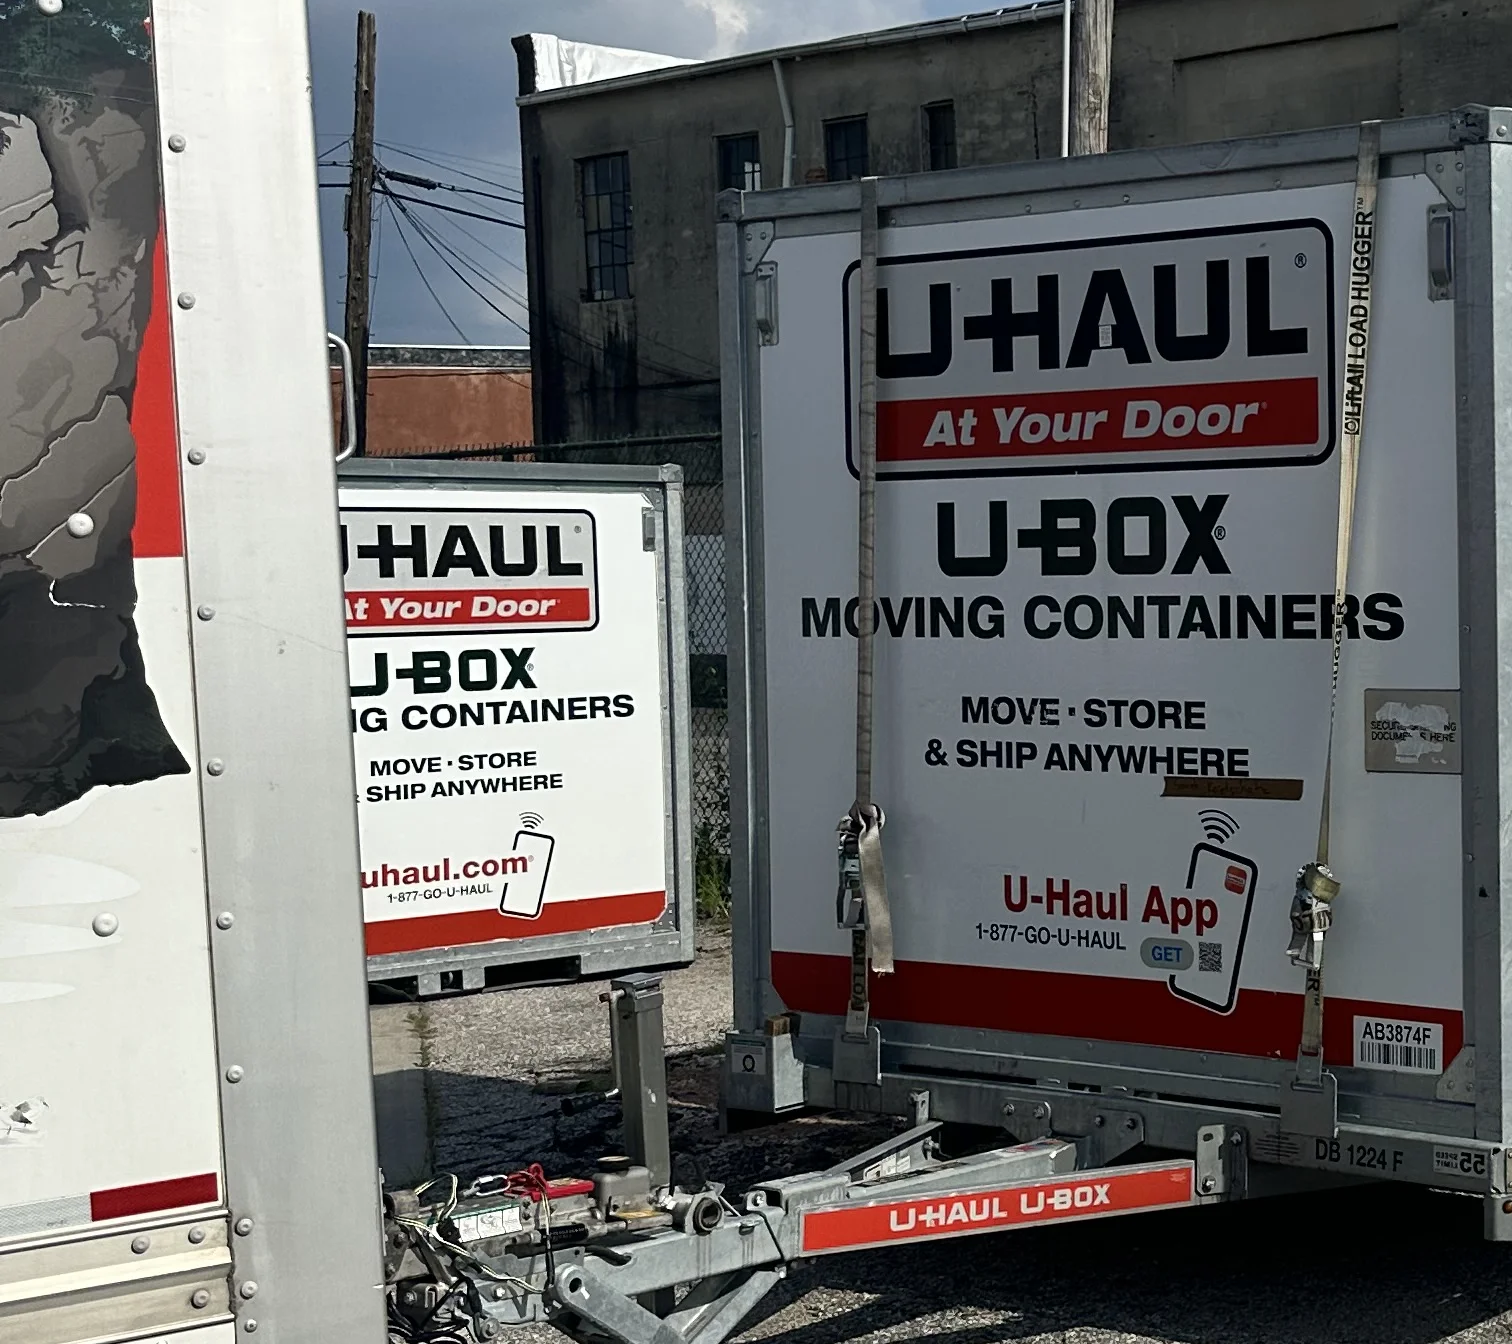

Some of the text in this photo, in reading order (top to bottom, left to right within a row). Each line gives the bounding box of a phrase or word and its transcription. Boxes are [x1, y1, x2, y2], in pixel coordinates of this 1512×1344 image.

[876, 256, 1308, 379] U-HAUL
[1348, 305, 1368, 360] LOAD
[924, 400, 1260, 448] At Your Door
[936, 494, 1232, 578] U-BOX
[379, 597, 461, 621] Your
[471, 595, 557, 617] Door
[801, 592, 1405, 640] MOVING CONTAINERS
[401, 694, 635, 730] CONTAINERS
[961, 696, 1206, 730] MOVE STORE
[370, 751, 537, 777] MOVE STORE
[924, 738, 1250, 777] & SHIP ANYWHERE
[366, 783, 427, 803] SHIP
[431, 773, 564, 798] ANYWHERE
[361, 856, 528, 889] uhaul.com
[387, 883, 493, 904] 1-877-GO-U-HAUL
[1004, 874, 1219, 936] U-Haul App
[975, 923, 1127, 951] 1-877-GO-U-HAUL
[1151, 945, 1183, 963] GET
[1362, 1021, 1432, 1045] AB3874F
[1315, 1138, 1341, 1163] DB
[1347, 1144, 1387, 1170] 1224
[1393, 1150, 1404, 1172] F
[890, 1183, 1111, 1232] U-HAUL U-BOX
